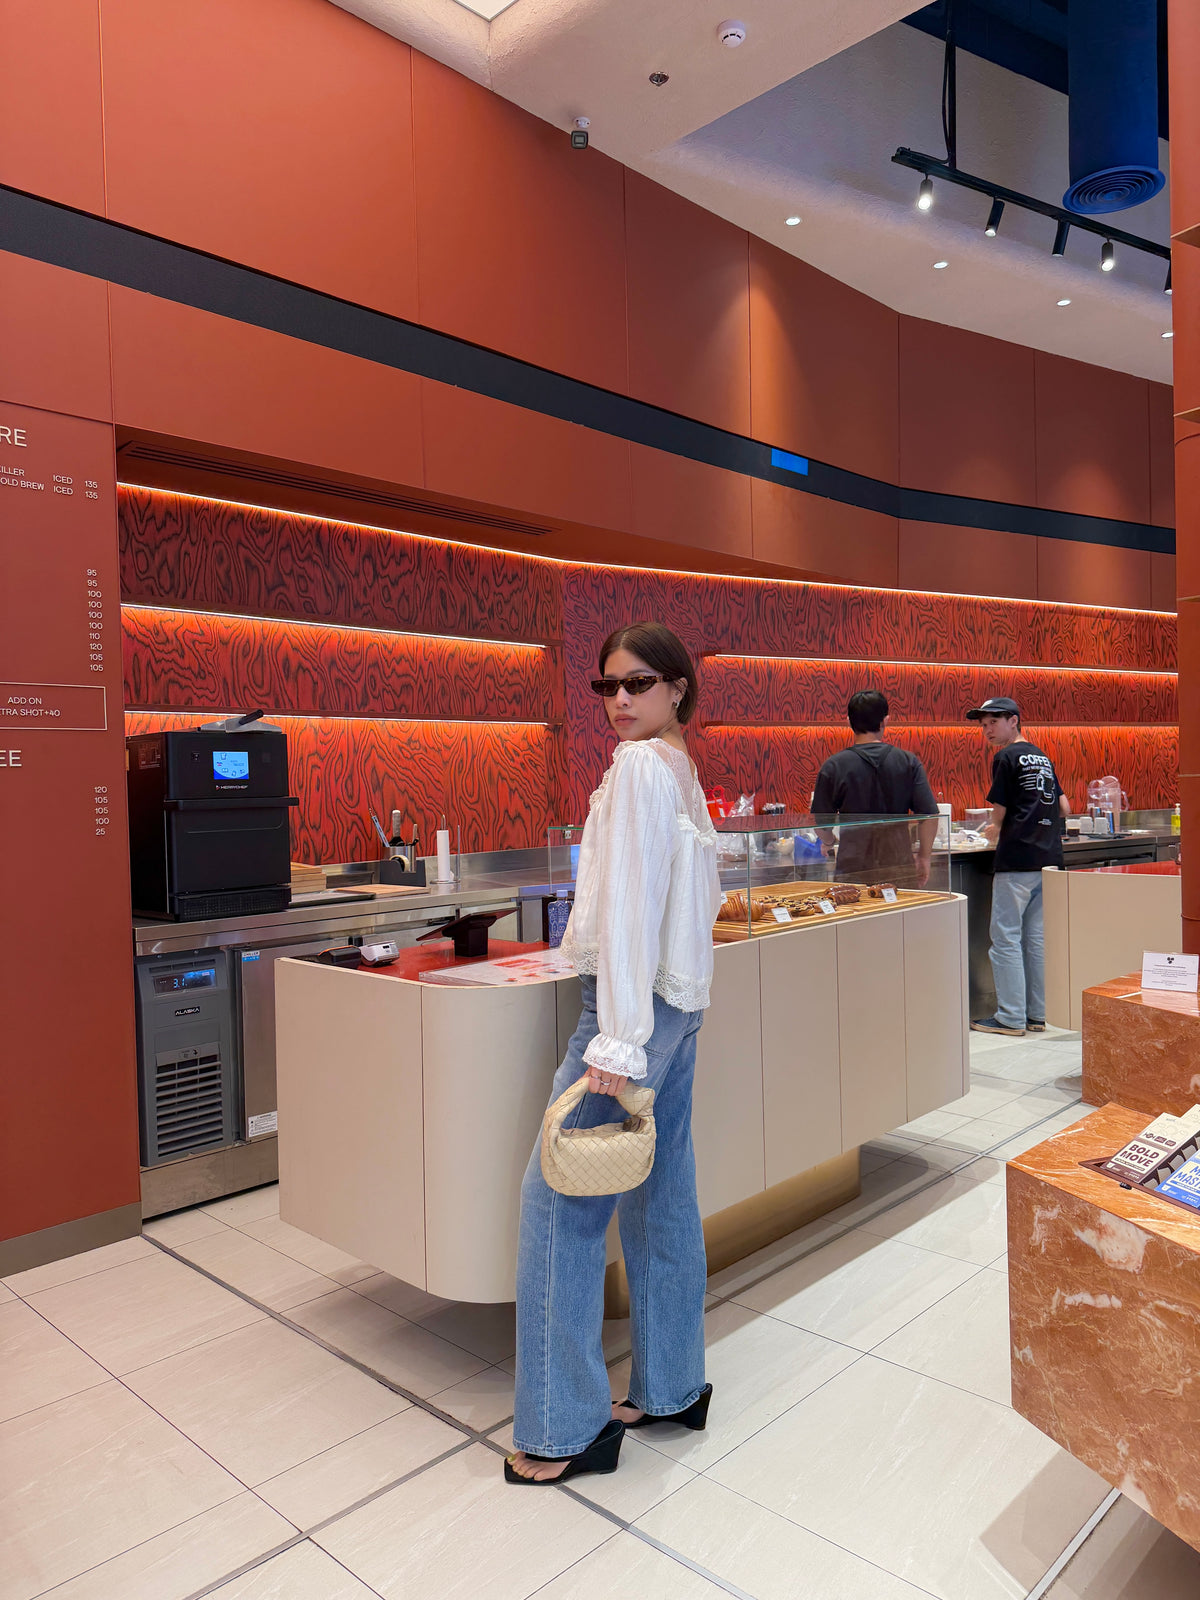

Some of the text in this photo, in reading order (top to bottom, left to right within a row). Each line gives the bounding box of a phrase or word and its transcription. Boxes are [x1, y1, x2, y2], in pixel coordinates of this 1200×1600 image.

[0, 425, 27, 447] RE
[53, 474, 73, 485] ICED
[85, 480, 98, 489] 135
[0, 477, 98, 500] OLD BREW ICED 135
[86, 568, 97, 577] 95
[87, 579, 98, 587] 95
[87, 590, 102, 598] 100
[88, 601, 102, 609] 100
[88, 611, 103, 619] 100
[88, 622, 103, 630] 100
[89, 632, 101, 640] 110
[89, 643, 103, 651] 120
[89, 653, 103, 661] 105
[90, 664, 104, 672] 105
[7, 696, 42, 705] ADD ON
[0, 708, 19, 716] TRA
[94, 785, 108, 794] 120
[94, 796, 108, 804] 105
[95, 807, 109, 815] 105
[95, 817, 110, 825] 100
[95, 828, 106, 836] 25
[1129, 1144, 1160, 1160] BOLD
[1120, 1150, 1154, 1167] MOVE
